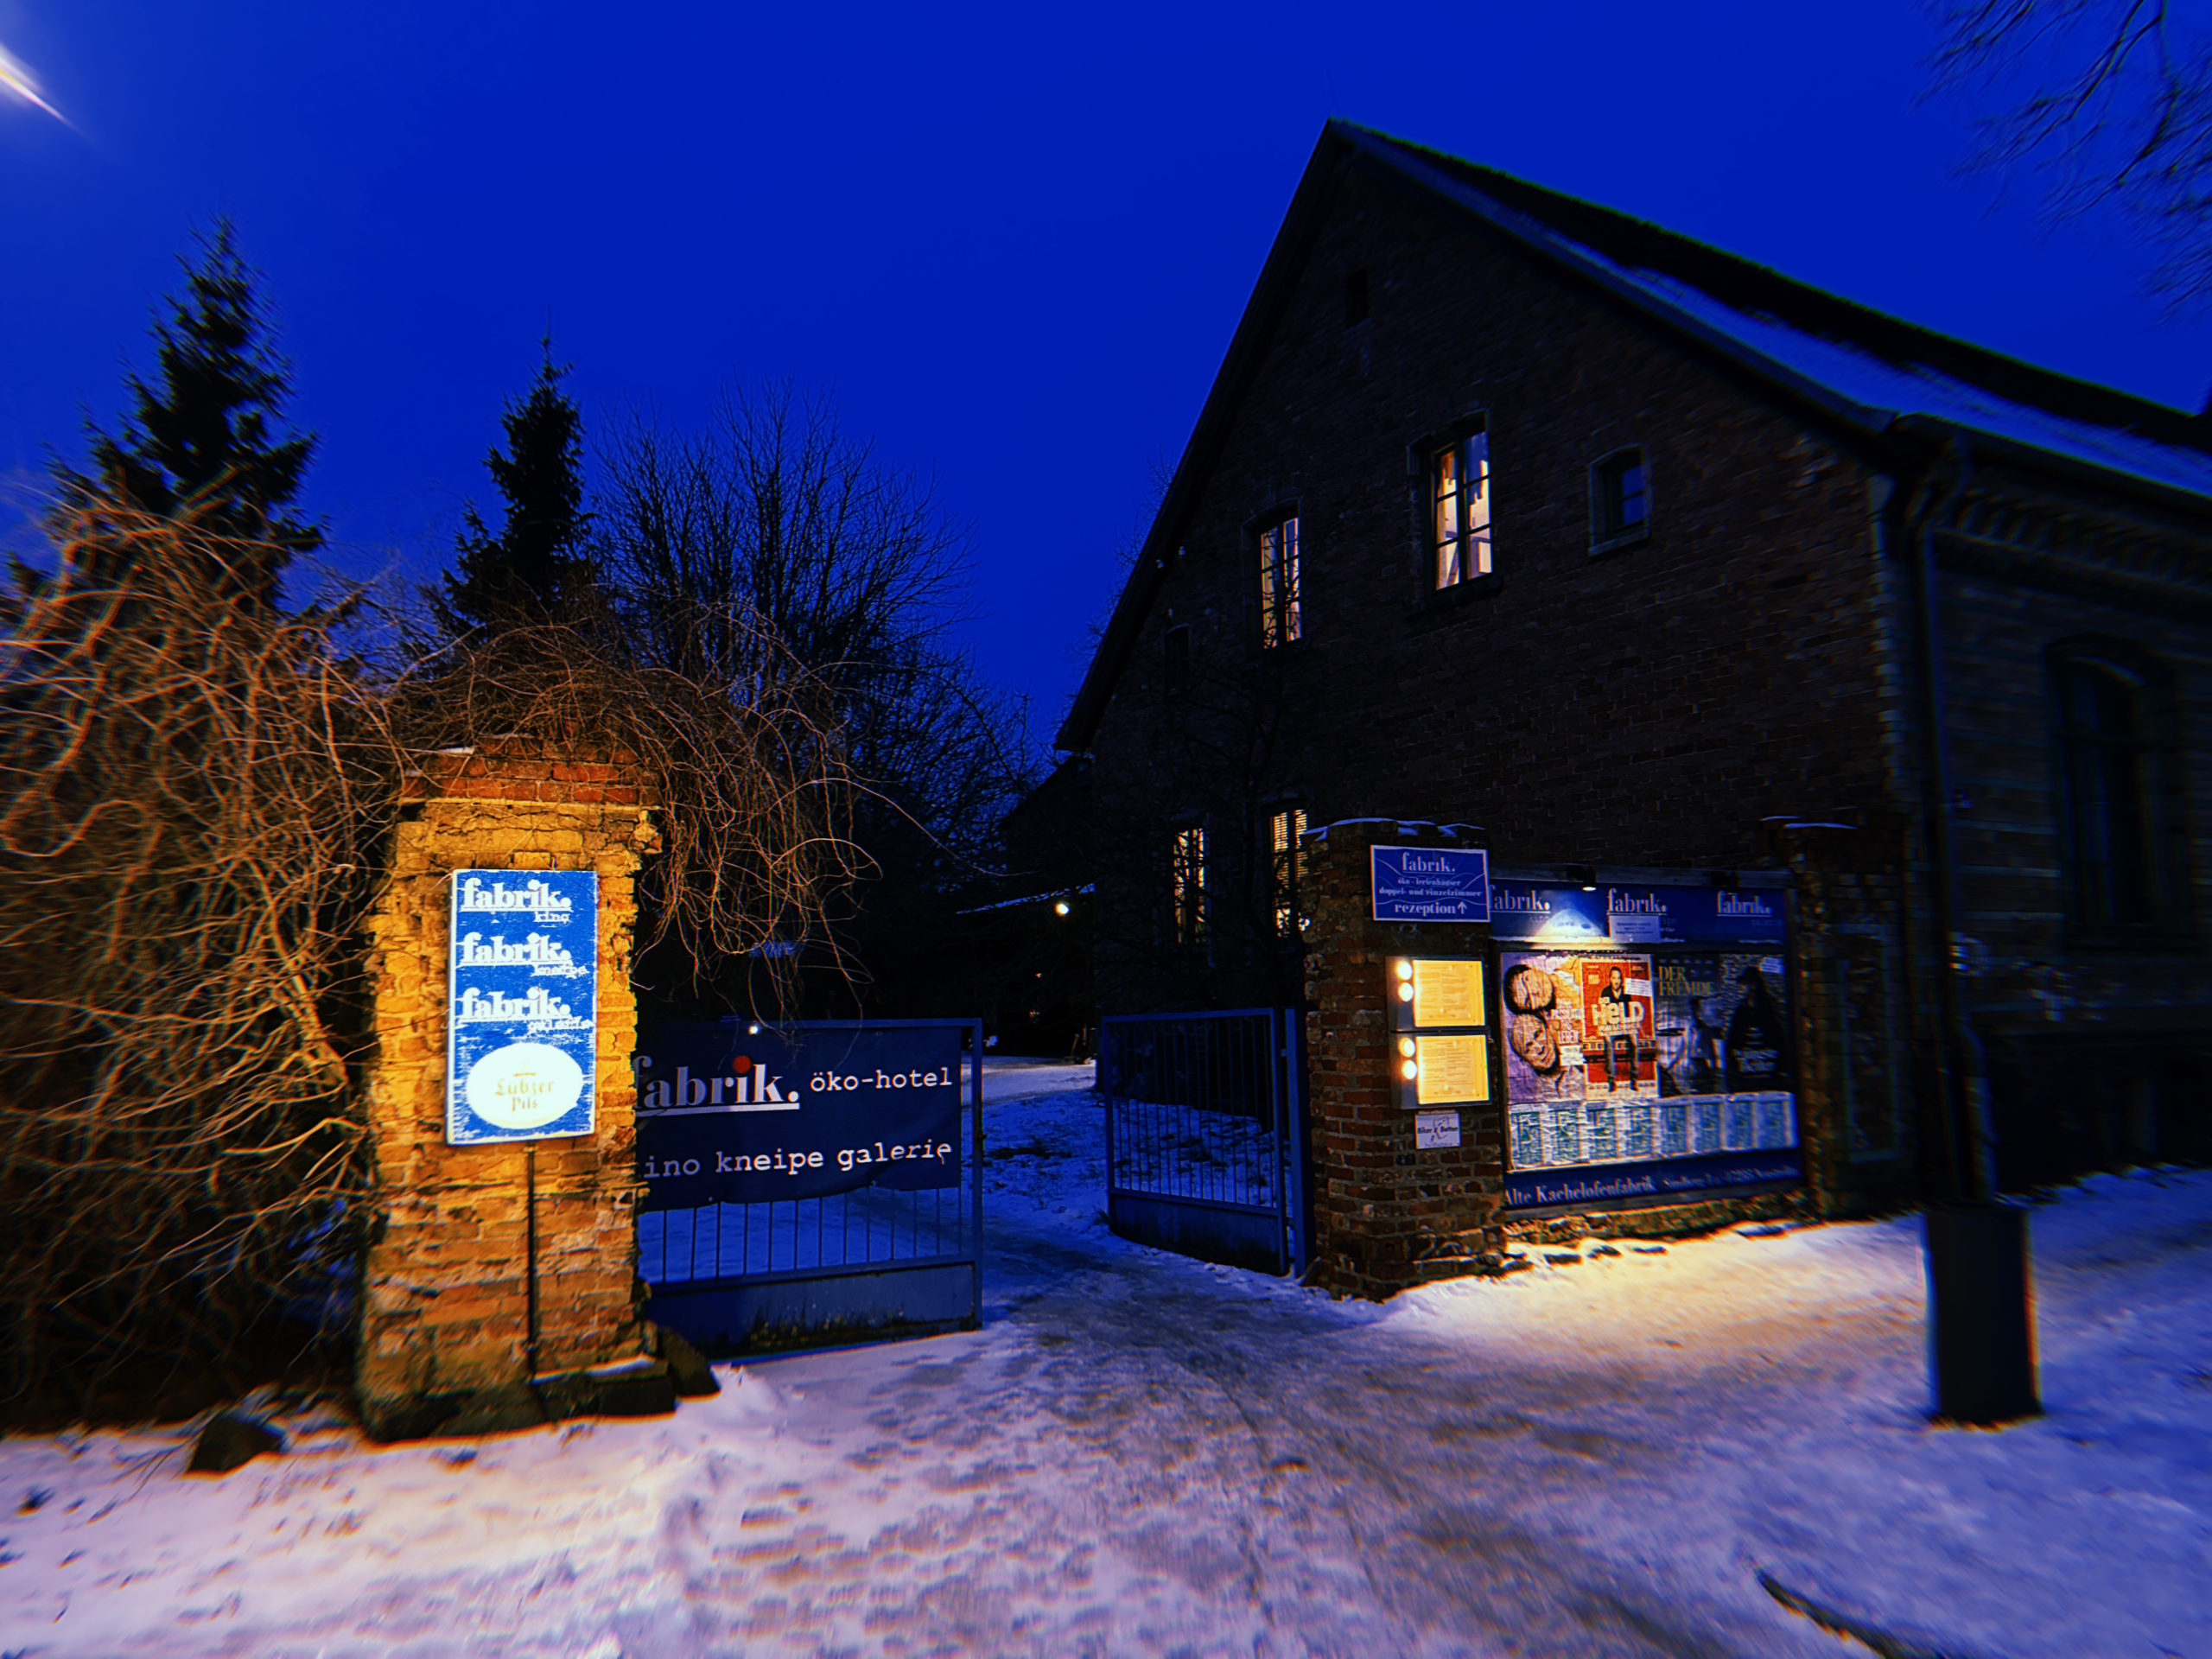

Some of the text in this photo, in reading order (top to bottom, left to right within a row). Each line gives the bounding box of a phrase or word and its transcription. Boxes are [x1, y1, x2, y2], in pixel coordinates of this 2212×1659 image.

[1402, 852, 1455, 872] fabrik.
[457, 877, 571, 908] fabrik.
[1607, 887, 1668, 912] fabrik.
[1717, 891, 1773, 914] fabrik.
[1394, 901, 1456, 917] rezeption
[456, 932, 571, 962] fabrik.
[1658, 965, 1687, 982] DER
[1658, 981, 1714, 996] FREMDE
[456, 987, 571, 1018] fabrik.
[810, 1067, 953, 1092] öko-hotel
[644, 1138, 953, 1179] ino kneipe galerie
[1535, 1174, 1658, 1204] Kachelofenfabrik
